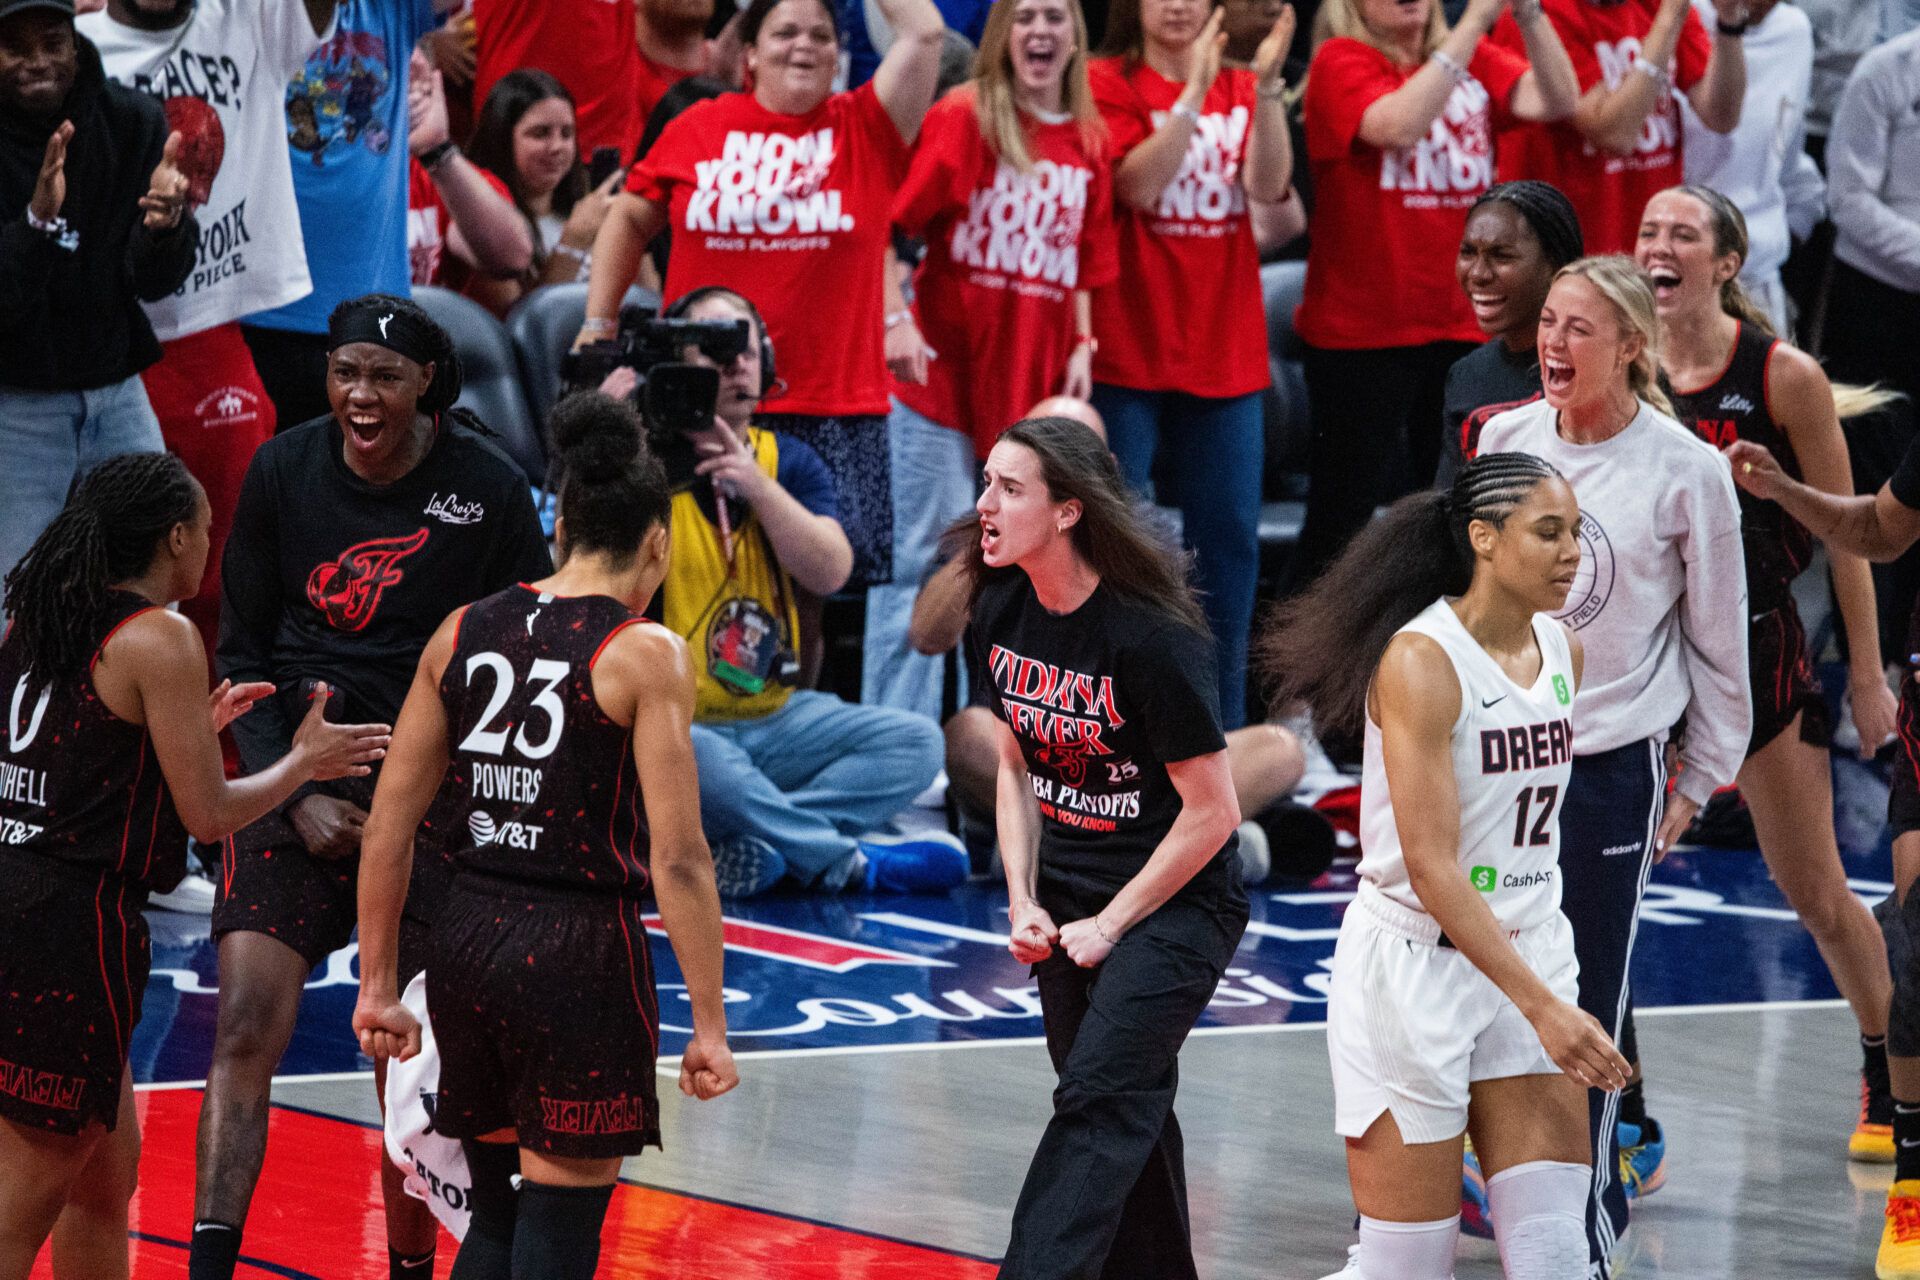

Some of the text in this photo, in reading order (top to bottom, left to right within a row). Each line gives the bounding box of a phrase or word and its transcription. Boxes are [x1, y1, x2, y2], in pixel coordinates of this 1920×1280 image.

[721, 127, 834, 165] NOW
[694, 158, 793, 198] YOU
[685, 189, 856, 235] KNOW.
[968, 186, 1057, 240] YOU
[193, 252, 247, 293] PIECE
[423, 492, 484, 524] LaCroix
[1572, 594, 1601, 626] FIELD
[457, 651, 570, 761] 23
[989, 643, 1126, 731] INDIANA
[472, 762, 543, 804] POWERS
[1027, 771, 1141, 819] BA PLAYOFFS
[0, 815, 44, 846] T&T
[1057, 808, 1082, 827] YOU
[1512, 784, 1559, 848] 12
[1602, 844, 1633, 857] adidas
